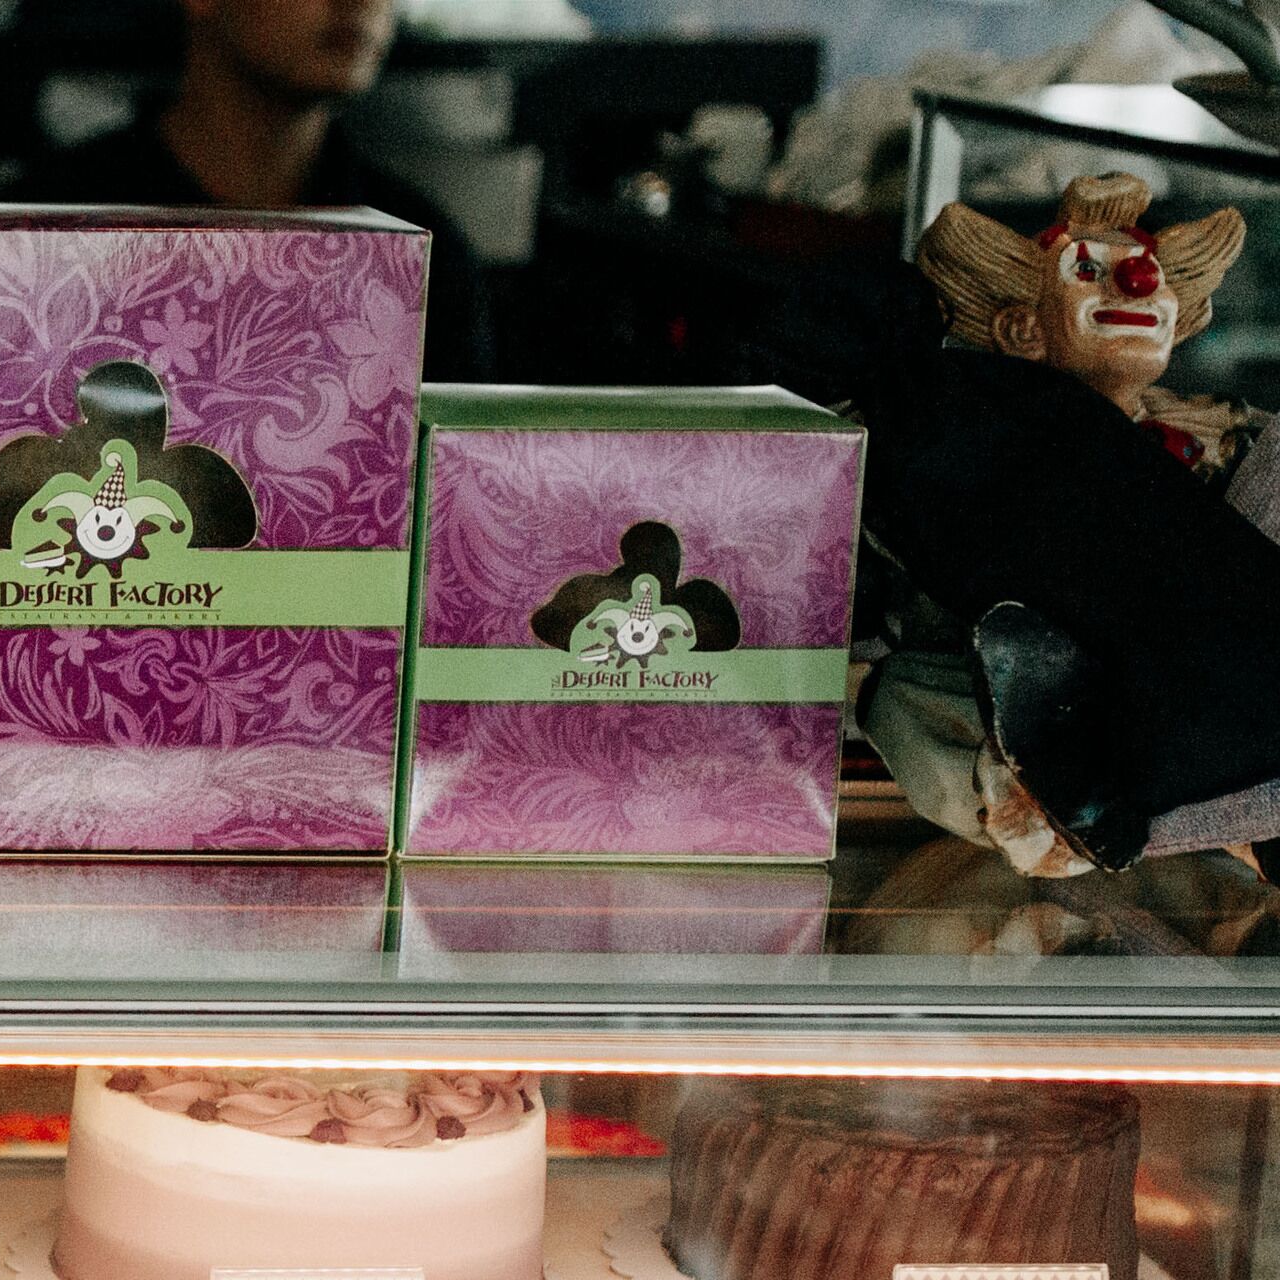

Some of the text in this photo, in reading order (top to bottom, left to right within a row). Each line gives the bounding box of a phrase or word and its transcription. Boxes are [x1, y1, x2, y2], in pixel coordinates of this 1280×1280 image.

[0, 580, 99, 608] DESSERT
[109, 580, 223, 609] FACTORY
[639, 669, 720, 689] FACTORY
